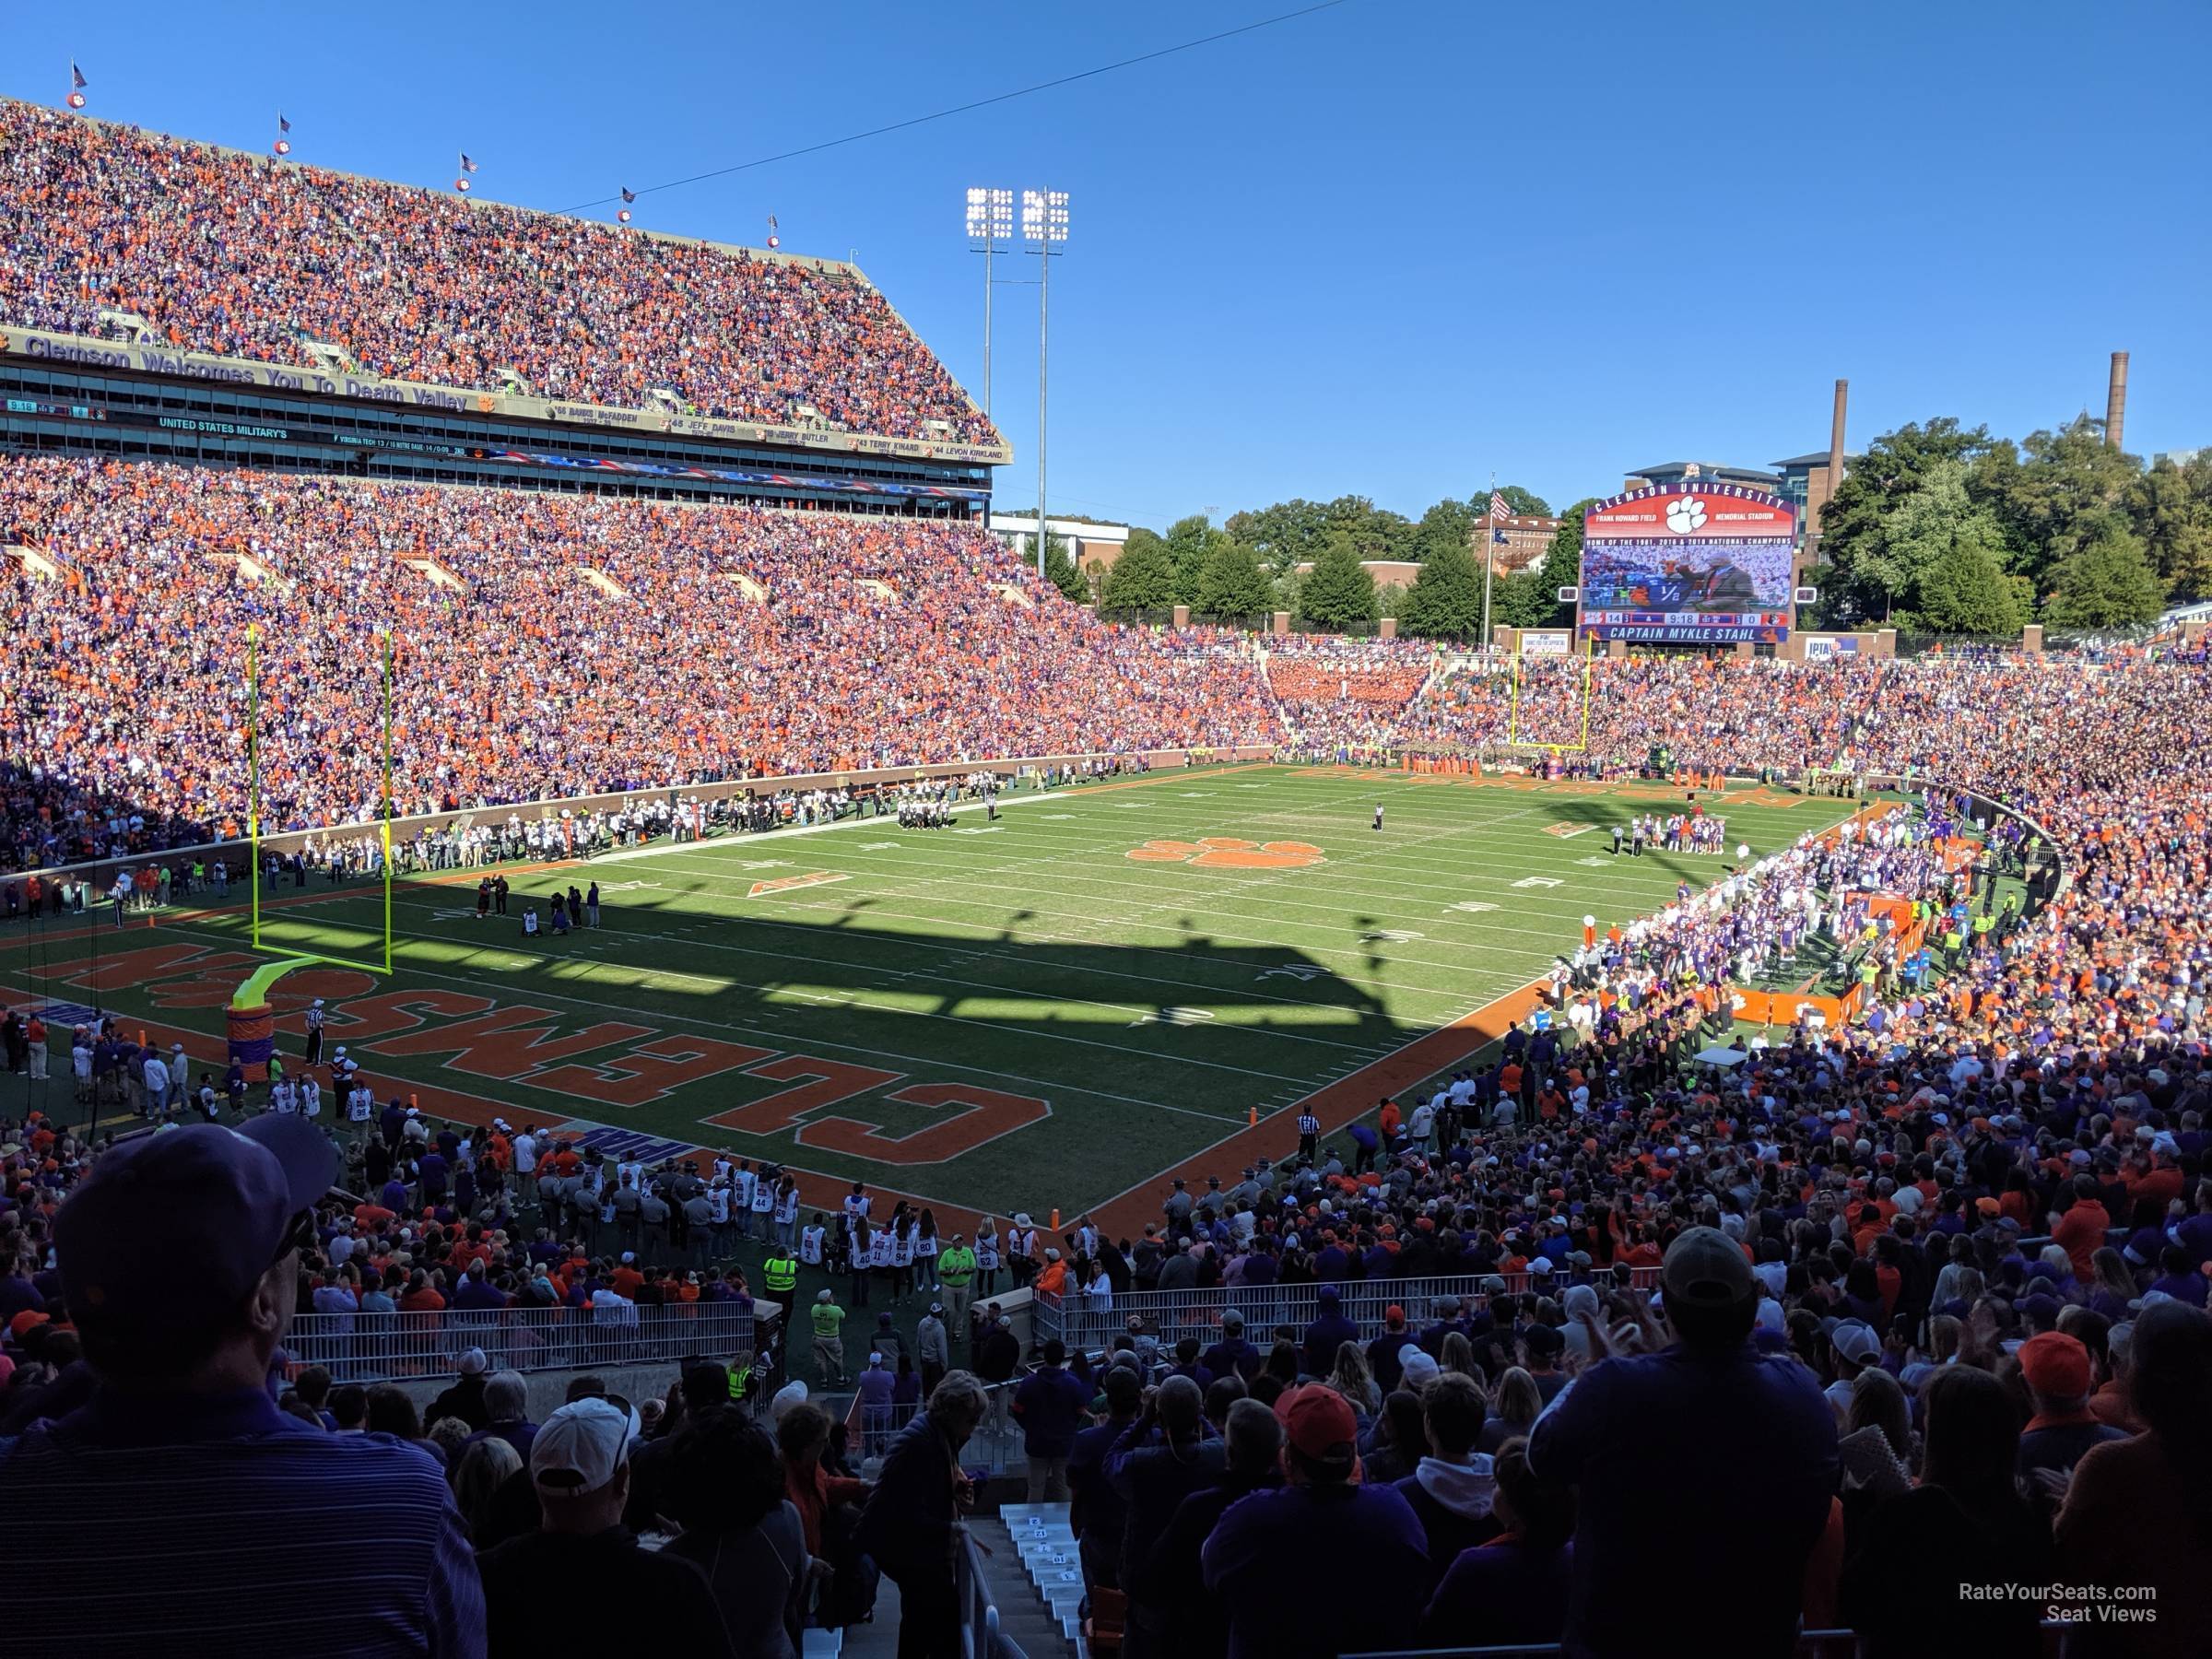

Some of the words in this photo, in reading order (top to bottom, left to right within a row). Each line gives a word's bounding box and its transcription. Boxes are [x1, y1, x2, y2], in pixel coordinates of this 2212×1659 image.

[25, 335, 131, 368] Clemson
[141, 351, 254, 383] Welcomes
[266, 369, 302, 391] You
[312, 374, 335, 394] To
[346, 379, 404, 403] Death
[413, 388, 467, 412] Valley
[598, 410, 638, 423] McFADDEN
[159, 417, 197, 430] UNITED
[198, 419, 235, 433] STATES
[236, 422, 288, 439] MILITARY'S
[668, 418, 684, 429] '45
[688, 420, 709, 431] JEFF
[712, 423, 735, 434] DAVIS
[801, 432, 829, 442] BUTLER
[869, 440, 892, 451] TERRY
[893, 441, 919, 452] KINARD
[946, 447, 969, 457] LEVON
[970, 448, 1003, 459] KIRKLAND
[1594, 485, 1667, 512] CLEMSON
[1681, 484, 1784, 510] UNIVERSITY
[1596, 514, 1614, 523] FRANK
[1616, 514, 1640, 523] HOWARD
[1641, 513, 1656, 522] FIELD
[1715, 512, 1747, 521] MEMORIAL
[1748, 512, 1774, 521] STADIUM
[1608, 614, 1620, 624] 14
[1670, 614, 1693, 624] 9:18
[1748, 614, 1755, 624] 0
[1610, 628, 1665, 638] CAPTAIN
[1669, 629, 1712, 640] MYKLE
[1715, 629, 1755, 640] STAHL
[1265, 964, 1332, 981] 20
[1141, 1007, 1215, 1026] 10
[1303, 1120, 1312, 1128] H
[756, 1198, 766, 1207] 44
[860, 1254, 870, 1264] 40
[874, 1252, 881, 1261] 11
[896, 1253, 907, 1262] 94
